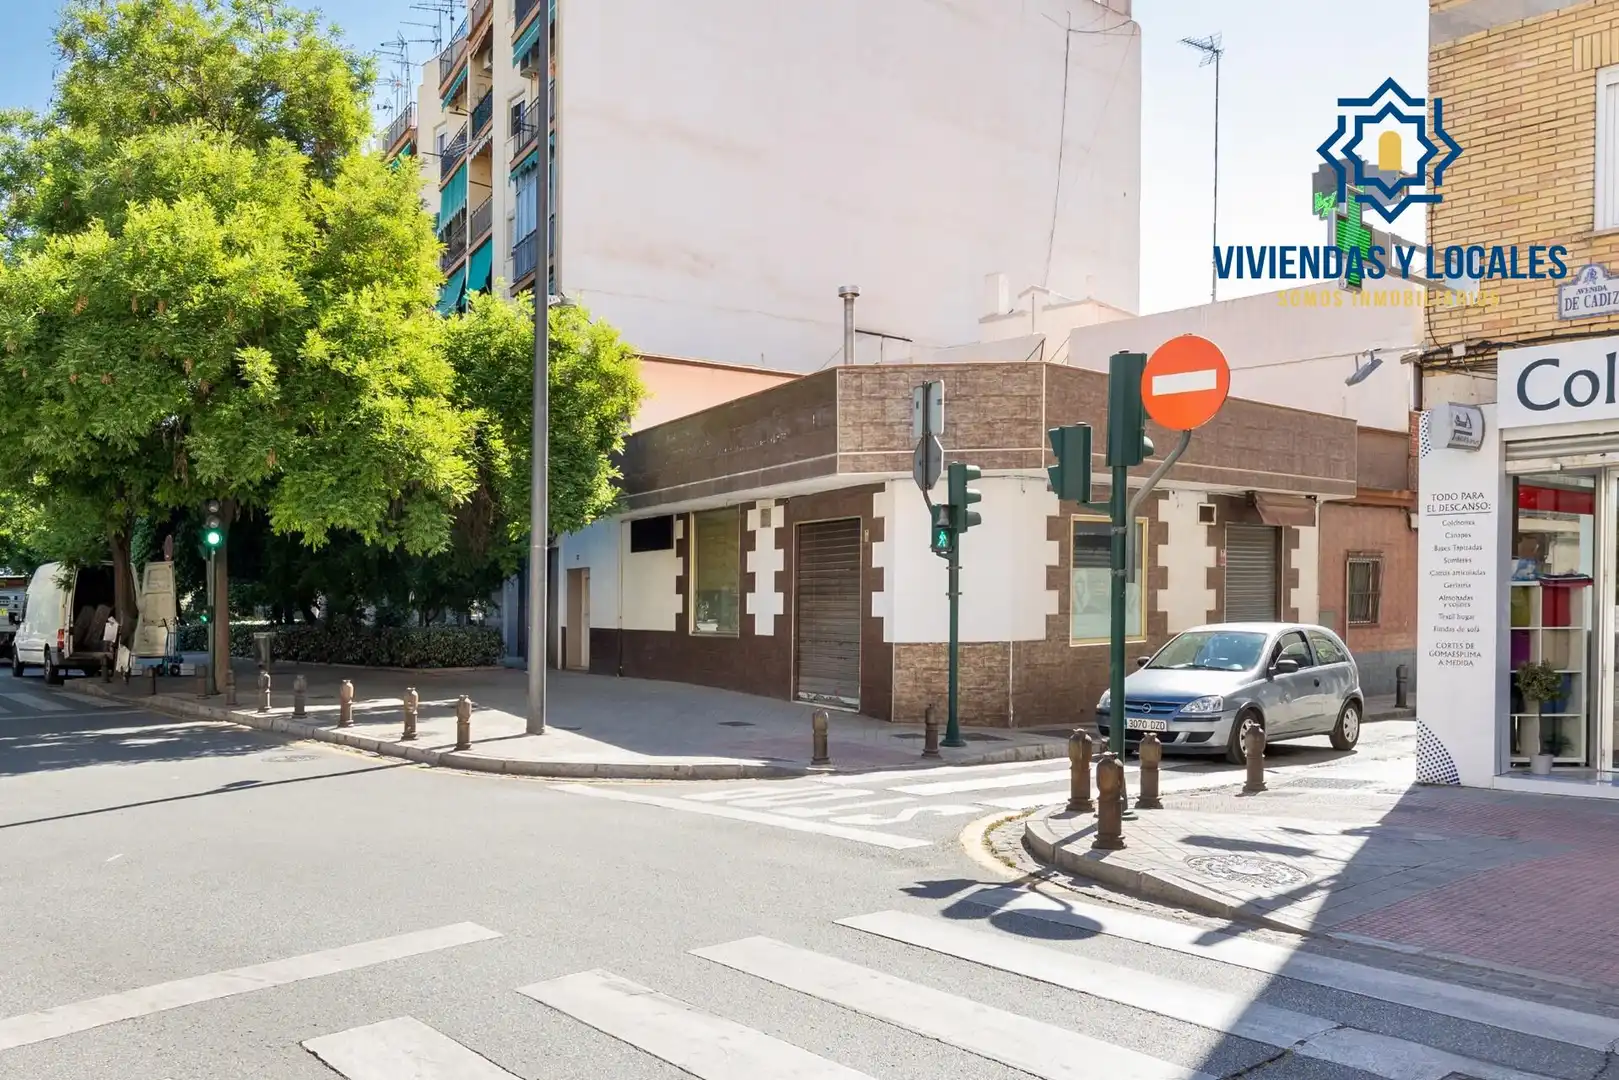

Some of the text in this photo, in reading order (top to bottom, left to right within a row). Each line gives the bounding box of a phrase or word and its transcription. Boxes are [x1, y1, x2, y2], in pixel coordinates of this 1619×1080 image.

[1576, 284, 1608, 296] AVENIDA
[1564, 290, 1619, 312] DE CADIZ
[1516, 351, 1618, 412] Col
[1432, 491, 1485, 501] TODO PARA
[1426, 501, 1491, 513] EL DESCANSO:
[1465, 642, 1475, 650] DE
[1129, 719, 1148, 729] 3070
